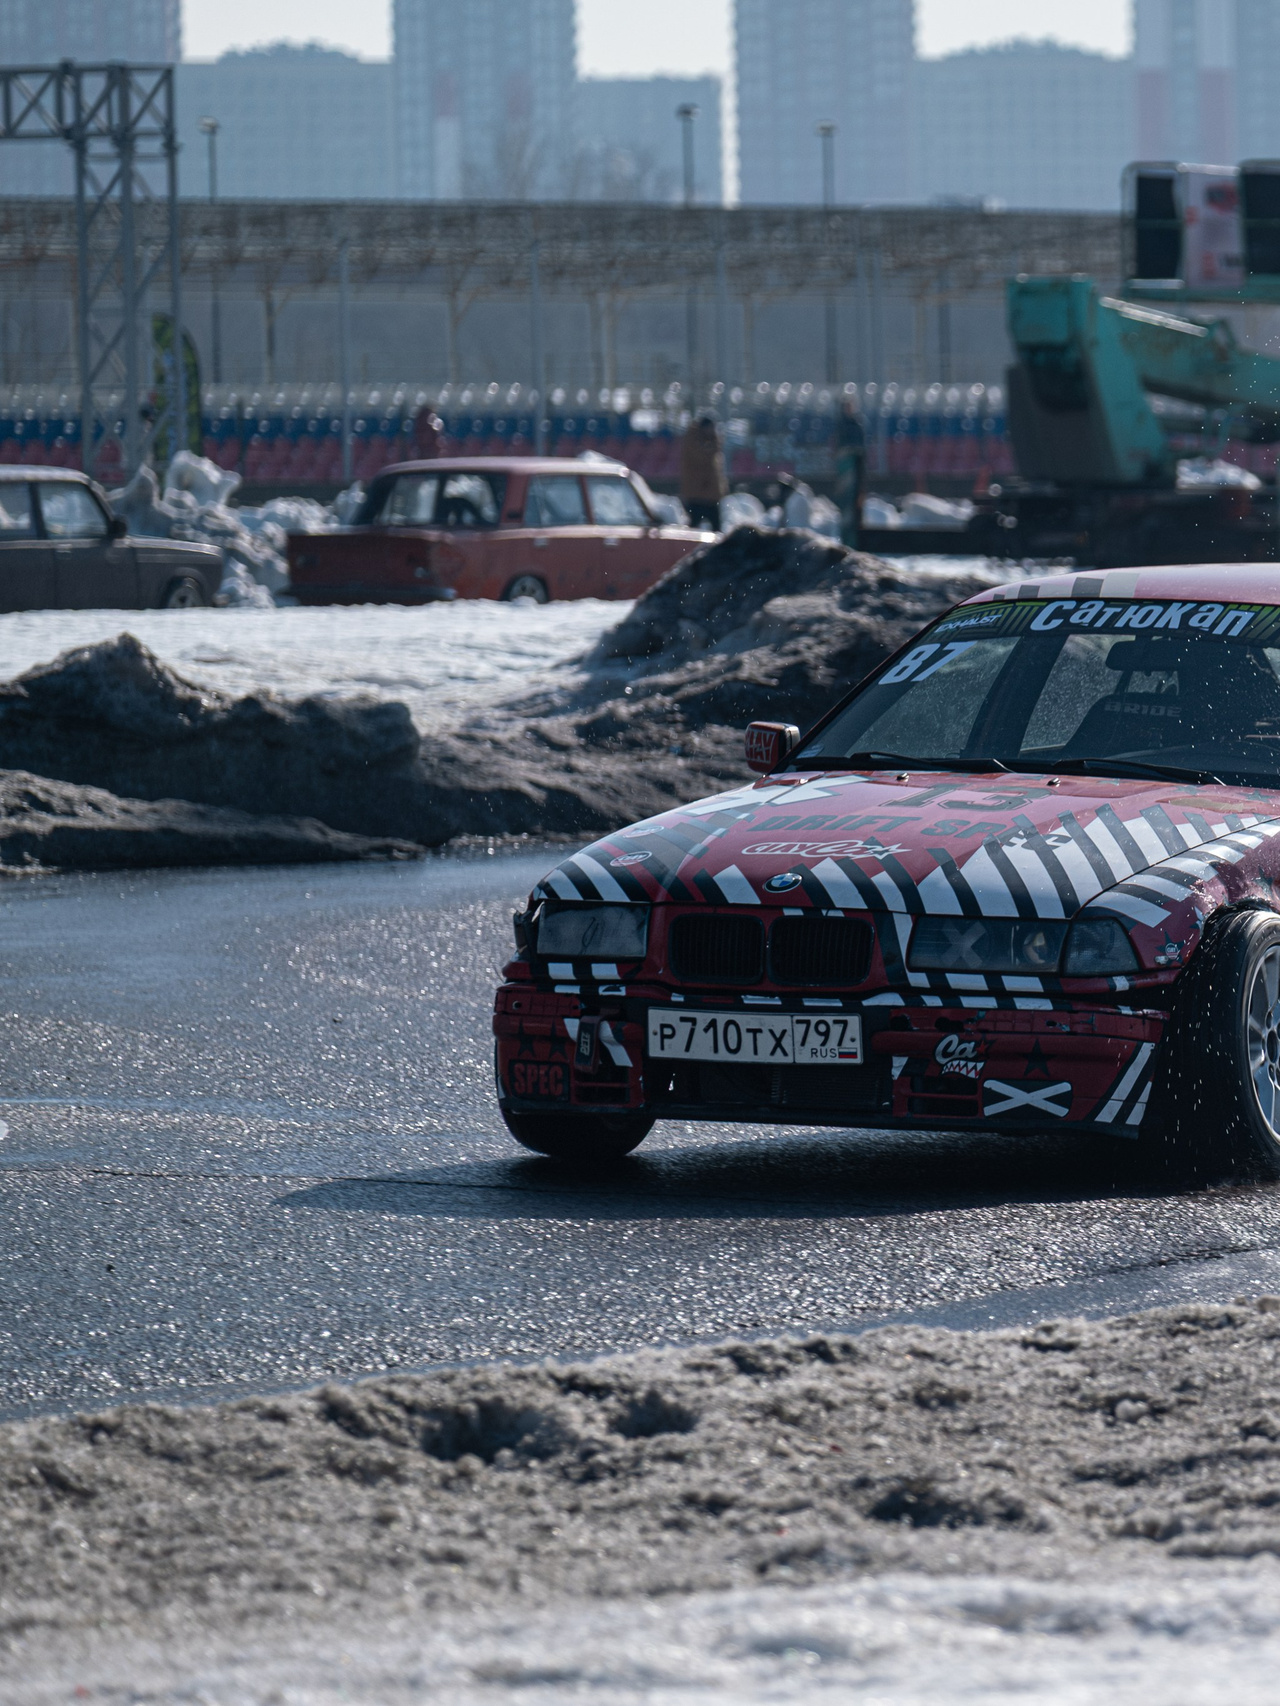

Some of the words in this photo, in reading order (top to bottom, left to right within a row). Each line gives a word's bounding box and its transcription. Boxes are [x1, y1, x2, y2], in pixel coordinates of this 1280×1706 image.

[933, 614, 1002, 634] EXHAUST
[878, 639, 978, 686] 87
[1103, 700, 1182, 718] BRIDE
[879, 782, 1061, 813] 13
[746, 814, 924, 833] DRIFT
[920, 818, 1074, 852] SPEC
[795, 1018, 849, 1047] 797
[810, 1047, 838, 1059] RUS
[512, 1061, 564, 1097] SPEC
